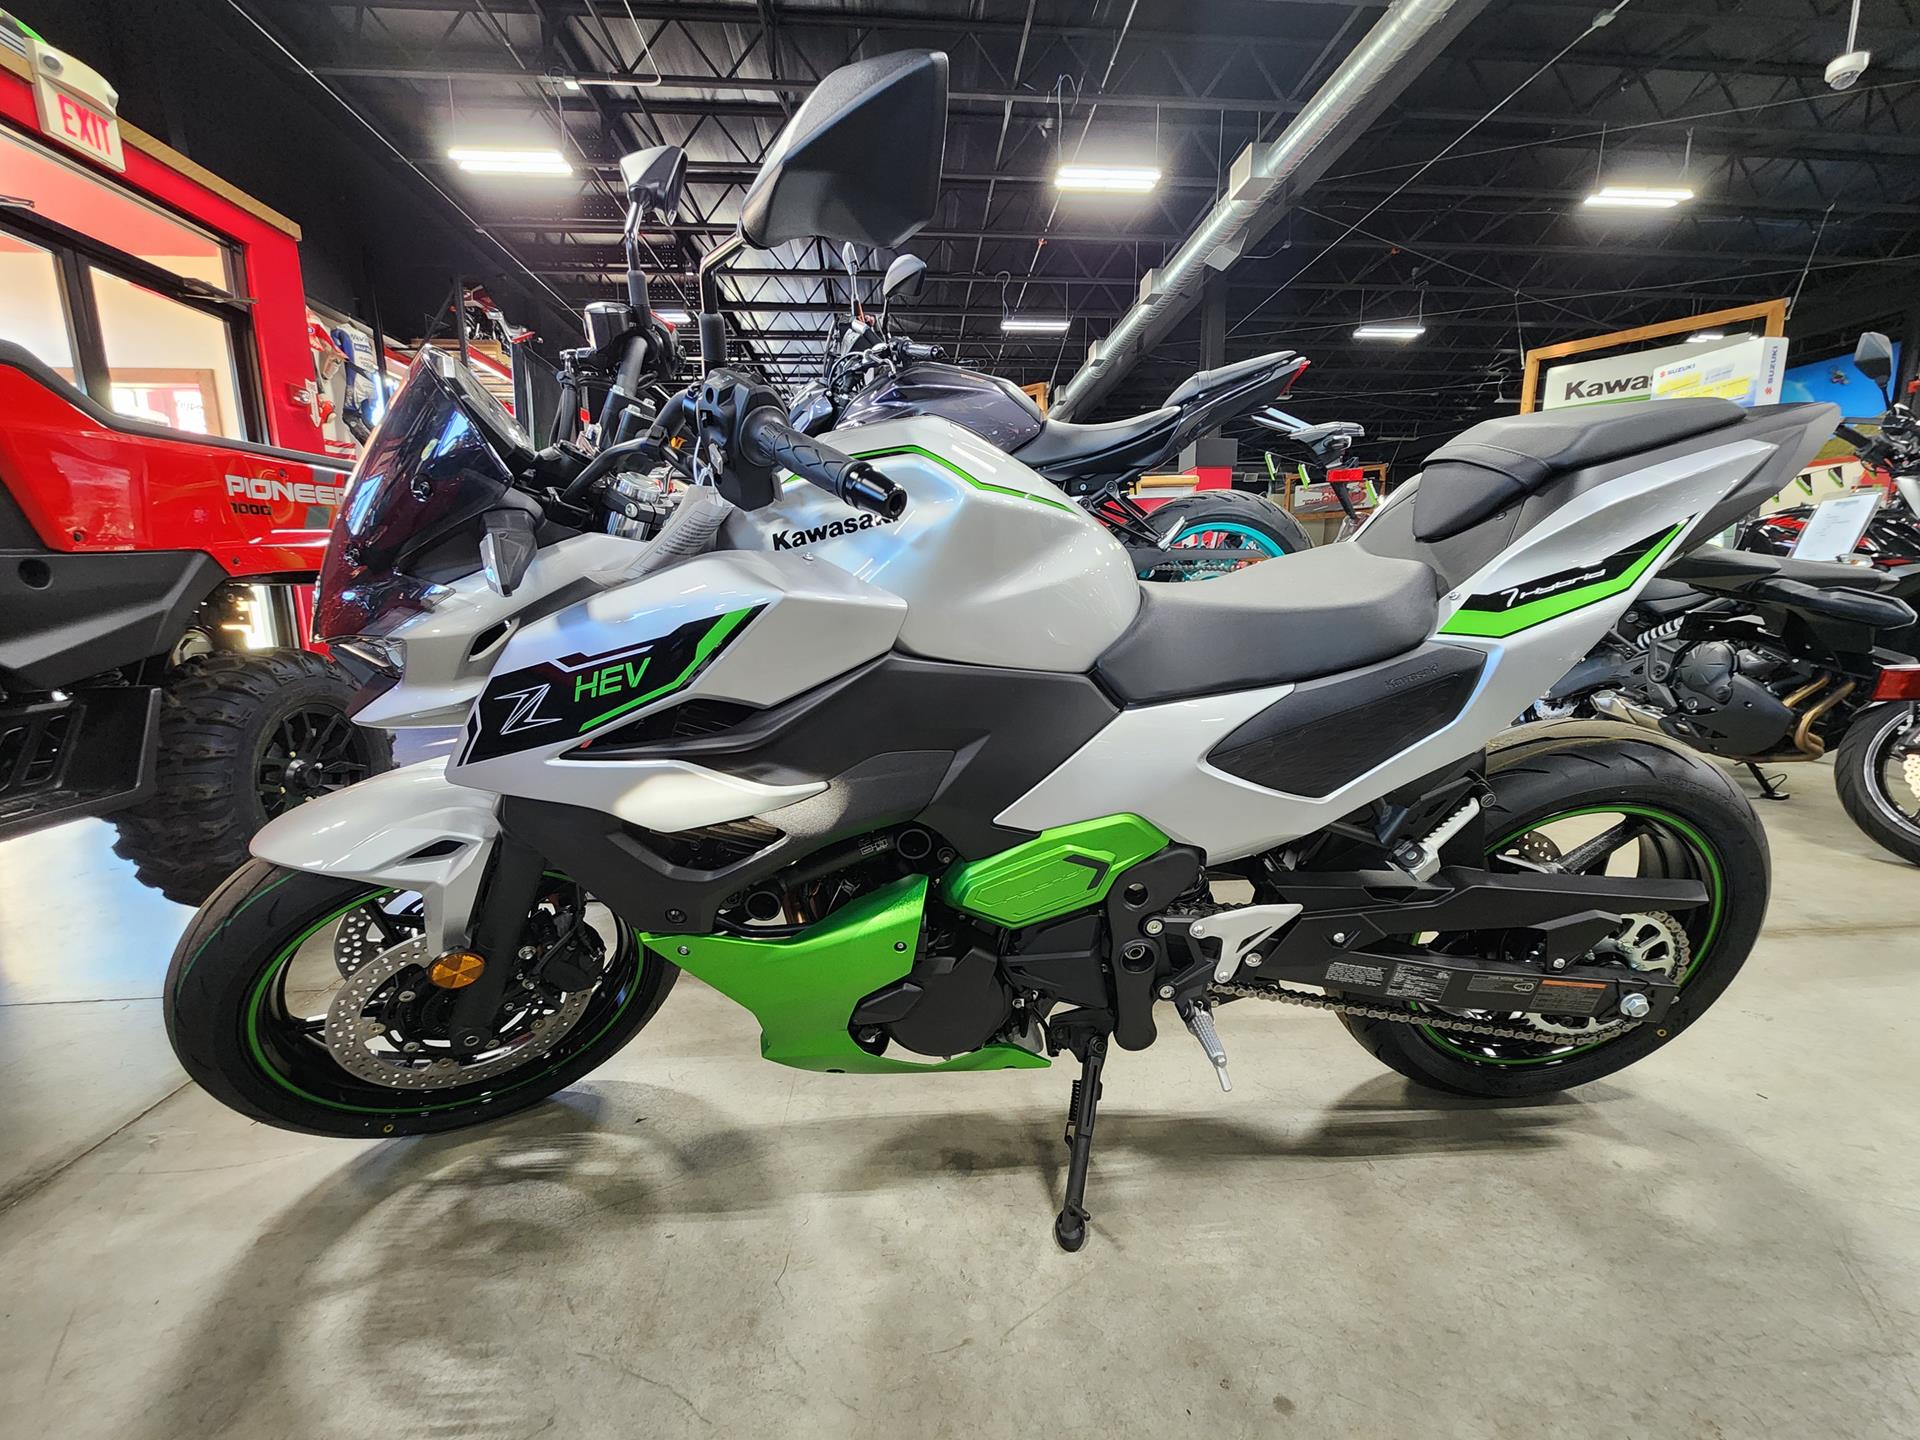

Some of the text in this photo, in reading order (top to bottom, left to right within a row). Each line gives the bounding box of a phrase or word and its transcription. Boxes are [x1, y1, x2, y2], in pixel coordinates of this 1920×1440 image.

[57, 93, 111, 156] EXIT
[1768, 346, 1778, 384] SUZUKI
[1564, 375, 1653, 401] Kawa
[574, 656, 652, 703] HEV
